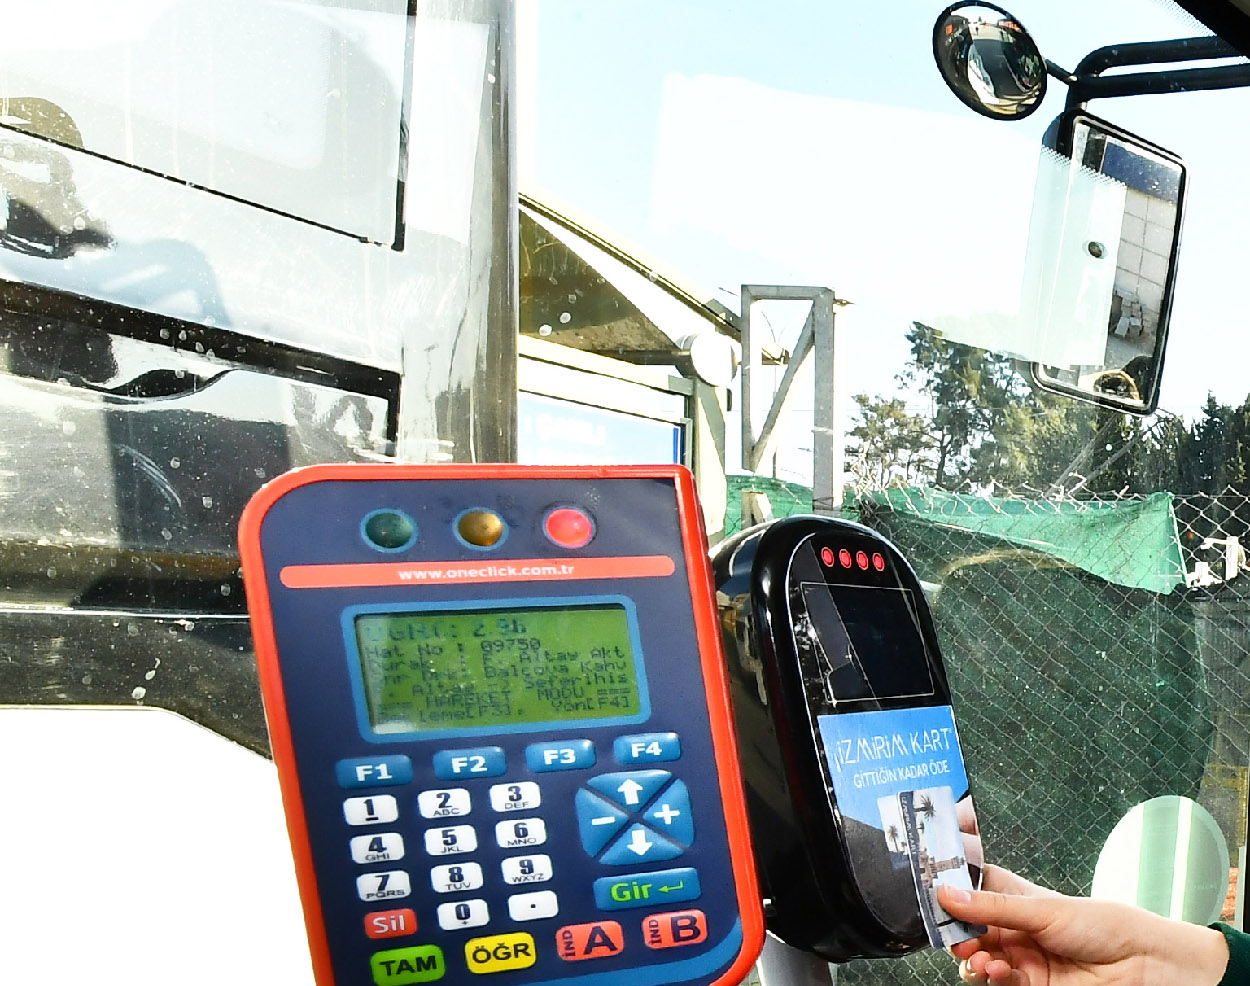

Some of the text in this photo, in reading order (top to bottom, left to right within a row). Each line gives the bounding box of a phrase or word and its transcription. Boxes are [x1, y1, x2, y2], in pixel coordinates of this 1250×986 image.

[398, 564, 574, 580] www.oneclick.com.tr
[479, 637, 541, 652] 09750
[590, 645, 624, 659] Akt
[536, 685, 584, 700] MODU
[910, 728, 951, 754] KART
[543, 748, 576, 764] F3
[631, 741, 662, 758] F4
[355, 763, 392, 782] F1
[451, 756, 487, 773] F2
[897, 763, 929, 779] KADAR
[929, 759, 951, 775] ÖDE
[436, 792, 452, 808] 2
[508, 786, 522, 801] 3
[364, 798, 375, 816] 1
[433, 808, 460, 817] ABC
[505, 801, 529, 810] DEF
[442, 829, 457, 846] 5
[514, 823, 529, 839] 6
[368, 836, 387, 853] 4
[440, 846, 464, 854] JKL
[507, 838, 536, 846] MNO
[365, 853, 390, 861] GHI
[448, 867, 464, 883] 8
[519, 859, 534, 875] 9
[375, 874, 390, 892] 7
[512, 873, 544, 883] WXYZ
[366, 889, 405, 899] PQRS
[445, 882, 471, 891] TUV
[611, 881, 653, 902] Gir
[455, 904, 471, 920] 0
[373, 915, 405, 934] Sil
[671, 915, 701, 943] B
[583, 925, 618, 955] A
[472, 942, 532, 964] ÖĞR
[379, 955, 437, 977] TAM
